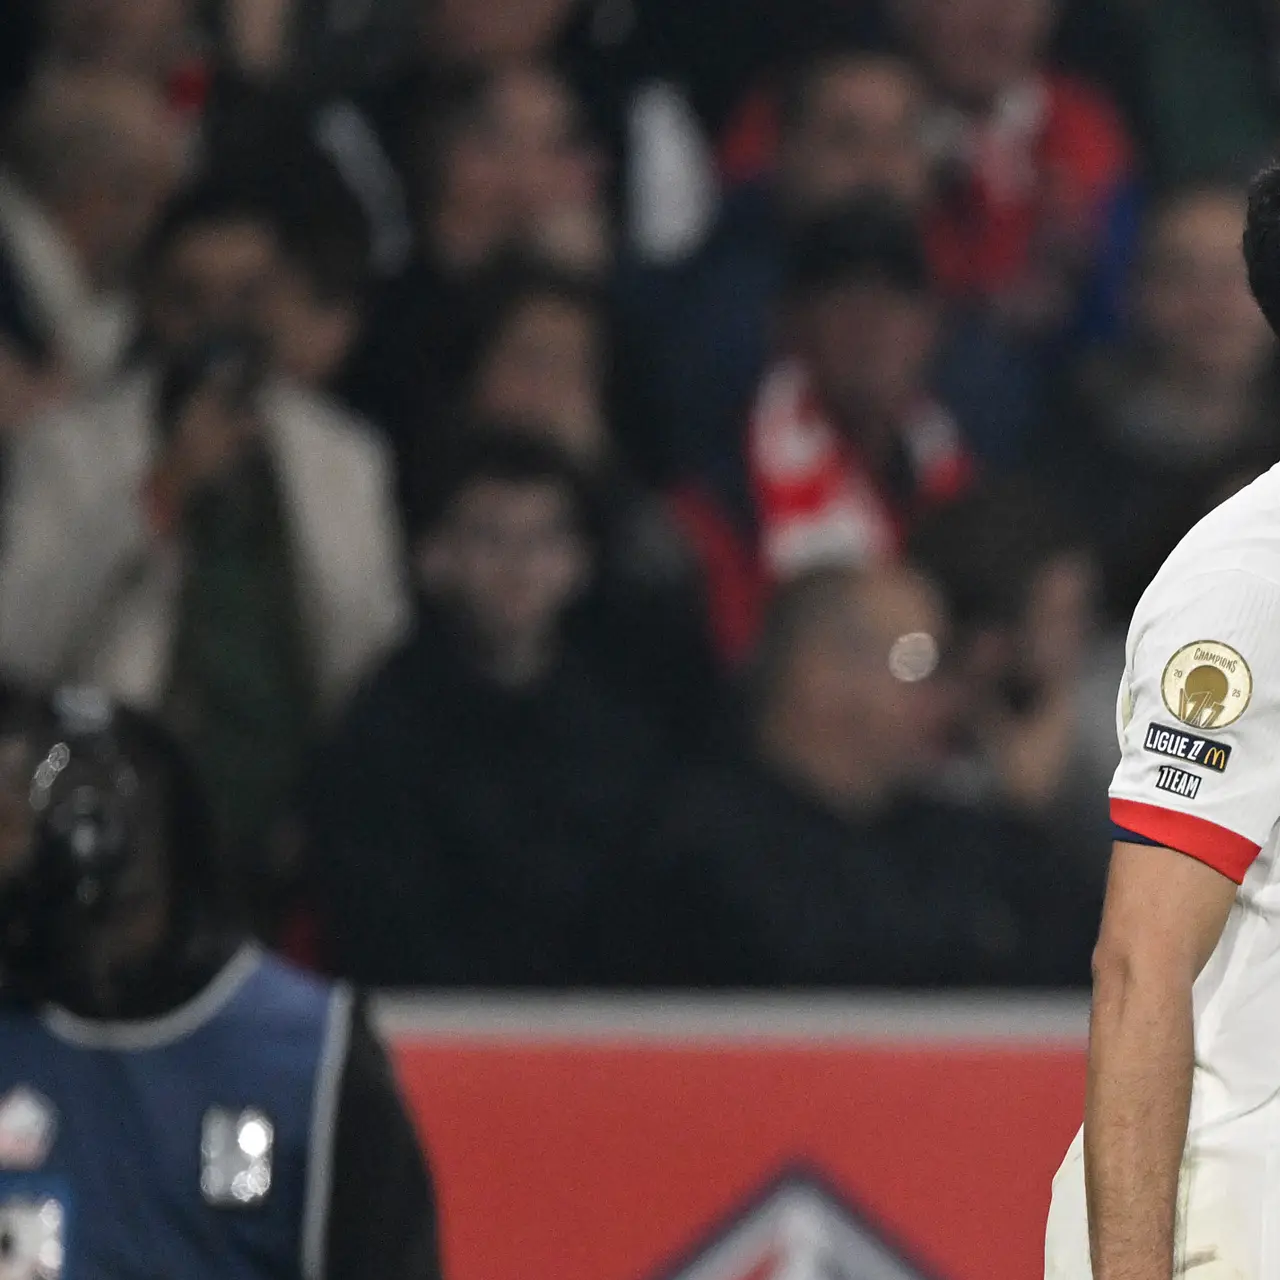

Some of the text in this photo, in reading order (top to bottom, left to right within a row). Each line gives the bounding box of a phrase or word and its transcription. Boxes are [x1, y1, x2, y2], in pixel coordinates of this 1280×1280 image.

[1173, 669, 1183, 678] 20
[1193, 647, 1238, 674] CHAMPIONS
[1146, 727, 1190, 758] LIGUE
